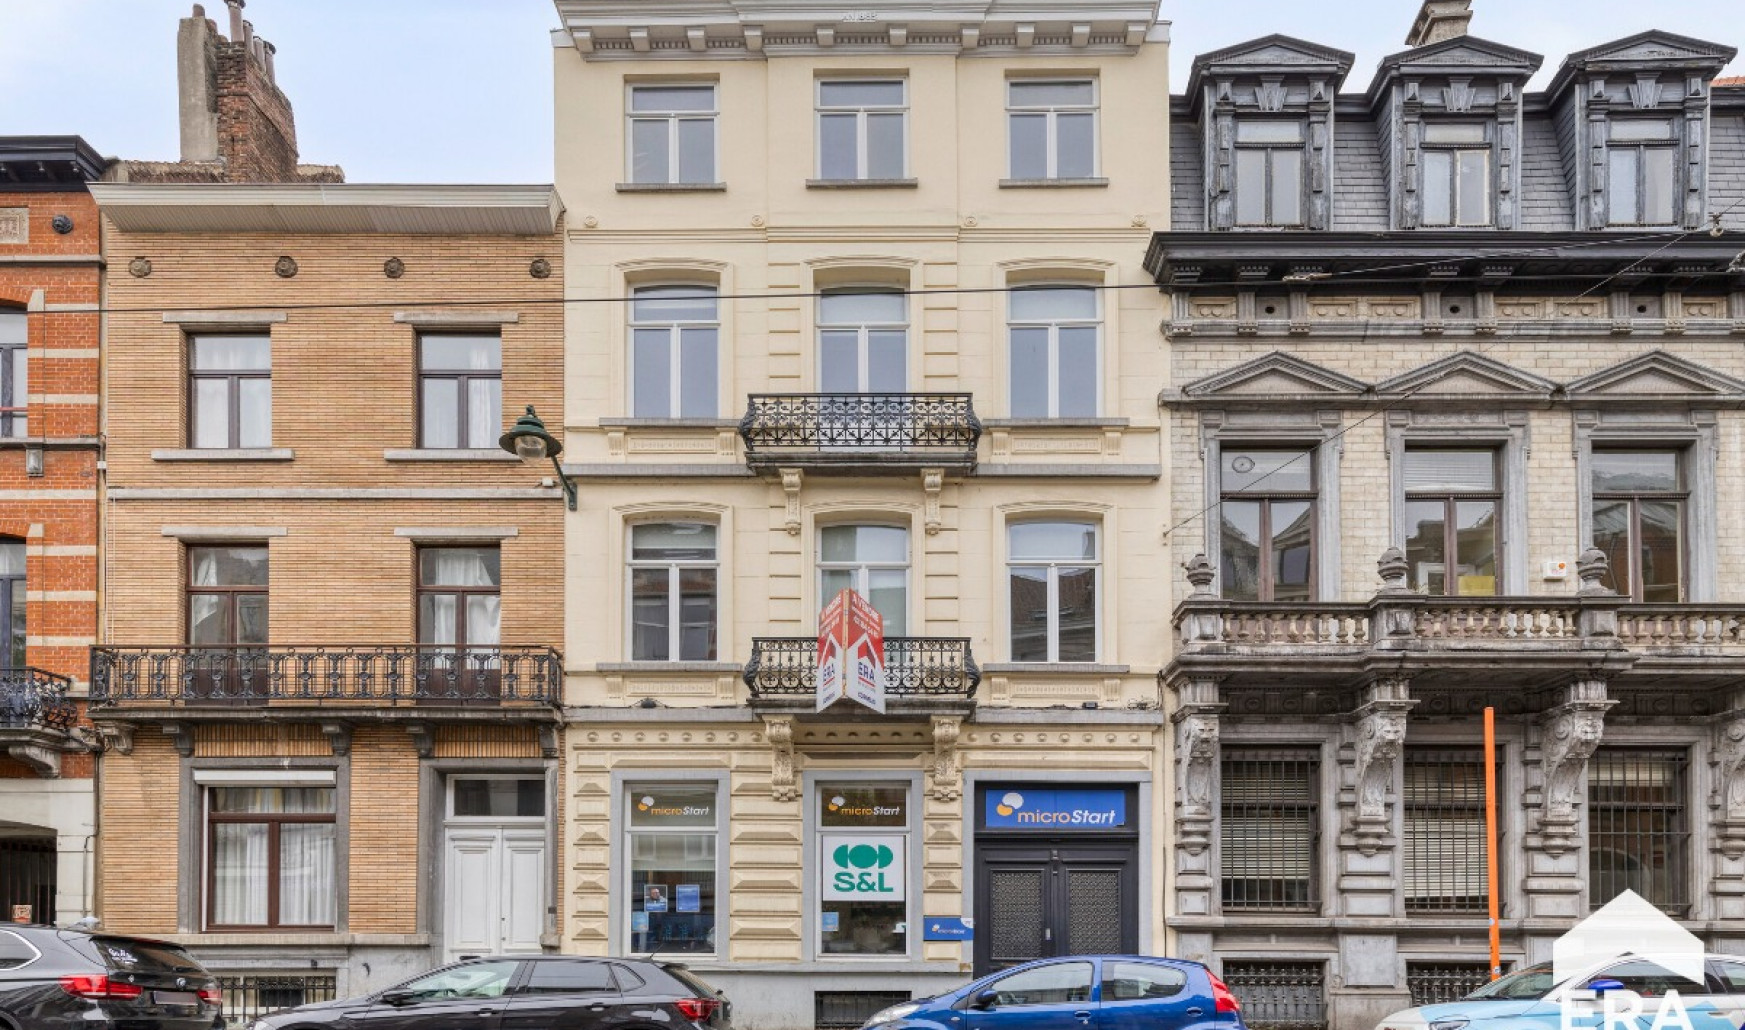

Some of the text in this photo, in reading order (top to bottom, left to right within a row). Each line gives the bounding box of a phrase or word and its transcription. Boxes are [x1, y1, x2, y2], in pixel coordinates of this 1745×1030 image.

[858, 662, 875, 681] ERA
[651, 806, 710, 816] microStart
[840, 806, 900, 816] microStart
[1017, 809, 1116, 824] microStart
[833, 872, 894, 893] S&L
